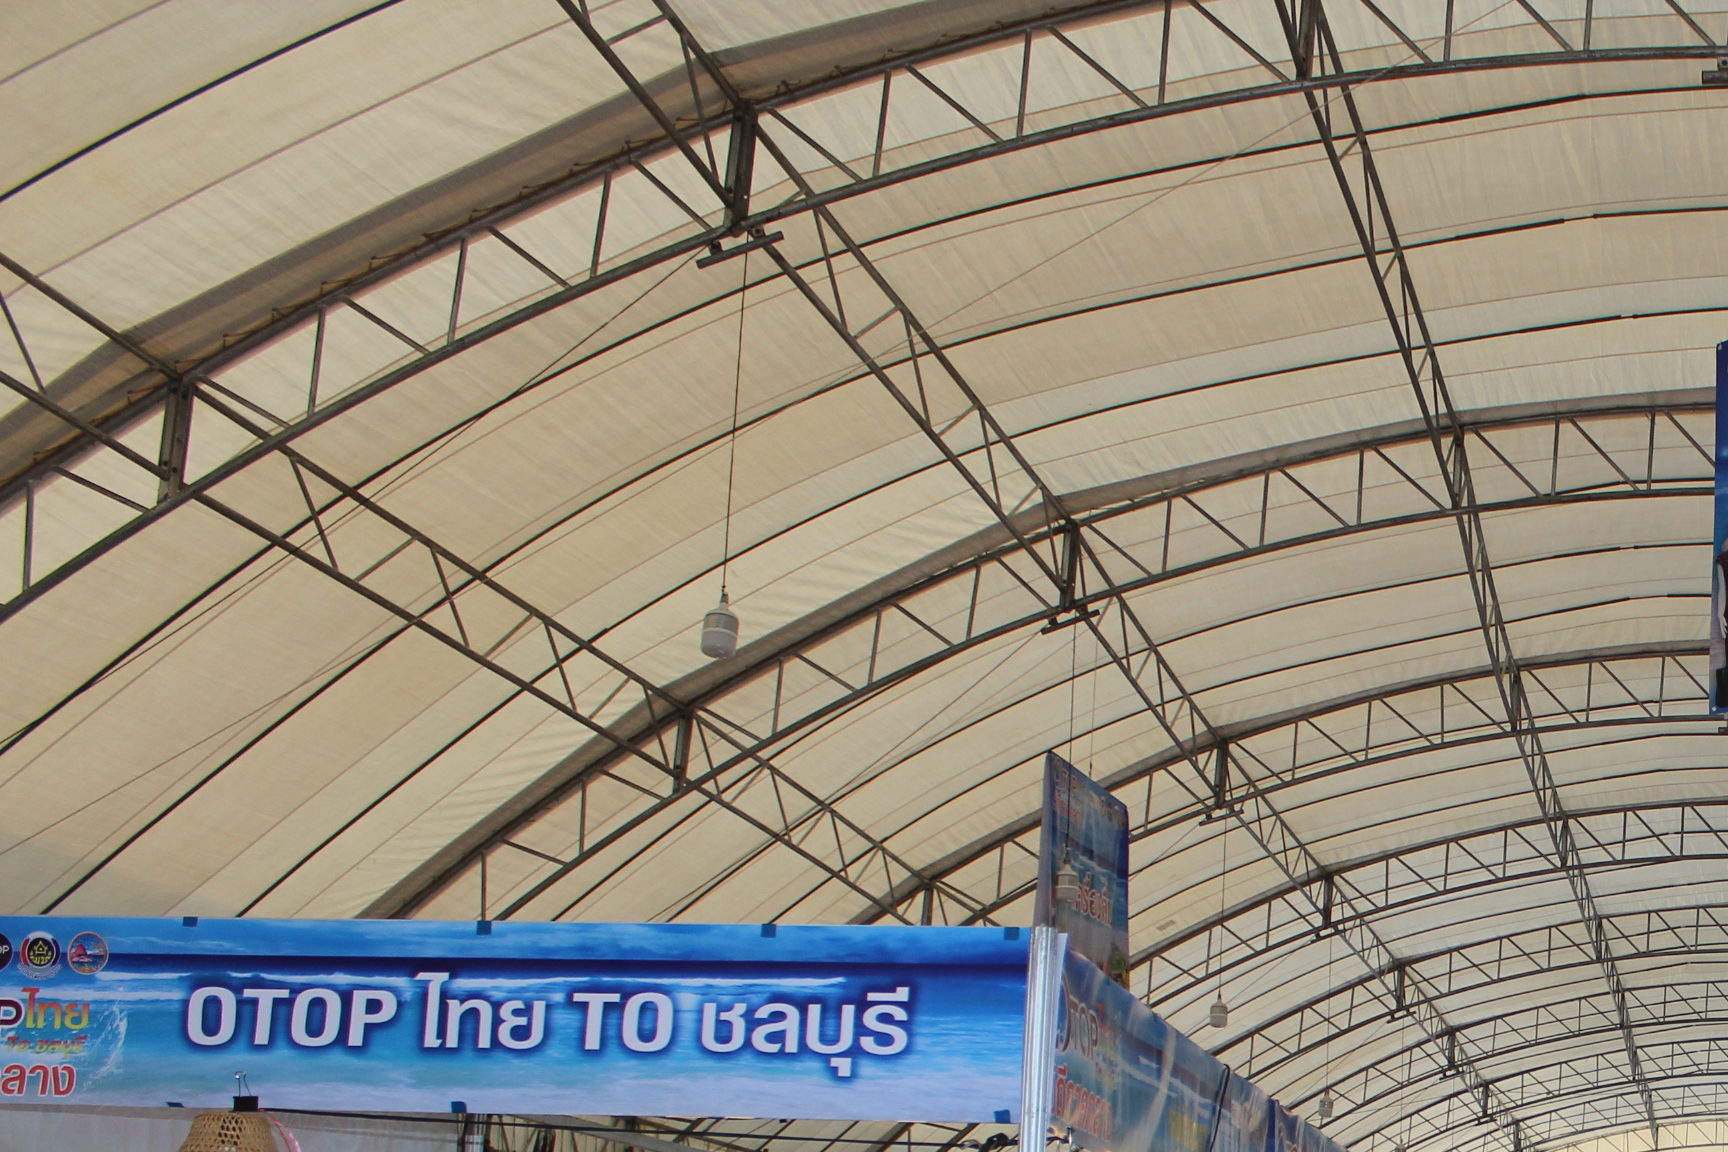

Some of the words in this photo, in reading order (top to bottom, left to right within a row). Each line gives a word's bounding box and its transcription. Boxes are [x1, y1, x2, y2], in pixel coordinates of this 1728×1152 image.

[21, 987, 90, 1029] ไทย
[187, 985, 398, 1048] OTOP
[416, 971, 546, 1051] ไทย
[573, 991, 674, 1052] TO
[700, 985, 912, 1078] ชลบุรี
